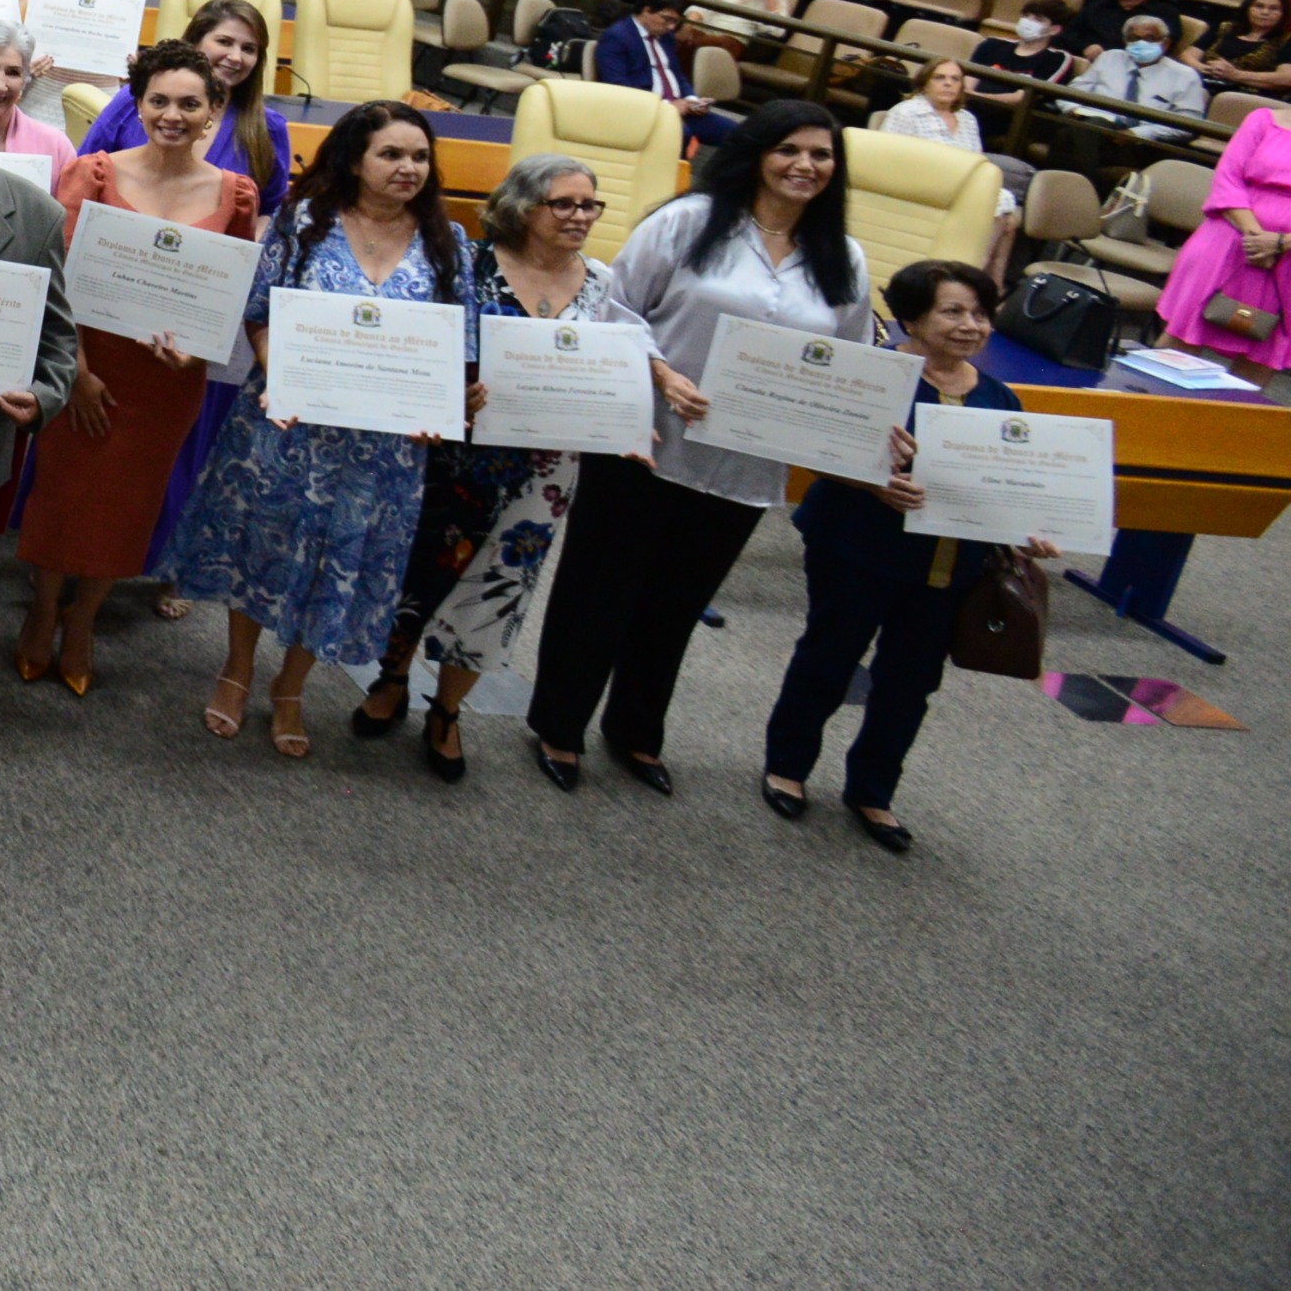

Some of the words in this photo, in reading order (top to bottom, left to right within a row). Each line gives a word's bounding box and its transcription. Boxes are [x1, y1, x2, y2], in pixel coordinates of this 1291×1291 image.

[98, 238, 136, 255] Diploma
[139, 248, 148, 258] de
[152, 252, 181, 266] Honra
[197, 263, 229, 278] Mérito
[170, 286, 197, 299] Martins
[295, 324, 337, 336] Diploma
[340, 328, 350, 338] de
[354, 330, 386, 342] Honra
[404, 335, 438, 348] Mérito
[300, 356, 332, 366] Luciana
[504, 352, 541, 363] Diploma
[544, 354, 553, 363] de
[557, 355, 584, 365] Honra
[599, 358, 628, 368] Mérito
[736, 353, 781, 370] Diploma
[784, 363, 795, 373] de
[799, 366, 832, 381] Honra
[834, 376, 847, 384] ao
[850, 377, 886, 393] Mérito
[769, 391, 796, 403] Regina
[798, 397, 806, 405] de
[809, 400, 842, 414] Oliveira
[942, 441, 984, 453] Diploma
[988, 445, 998, 454] de
[1002, 446, 1035, 457] Honra
[1052, 451, 1088, 462] Mérito
